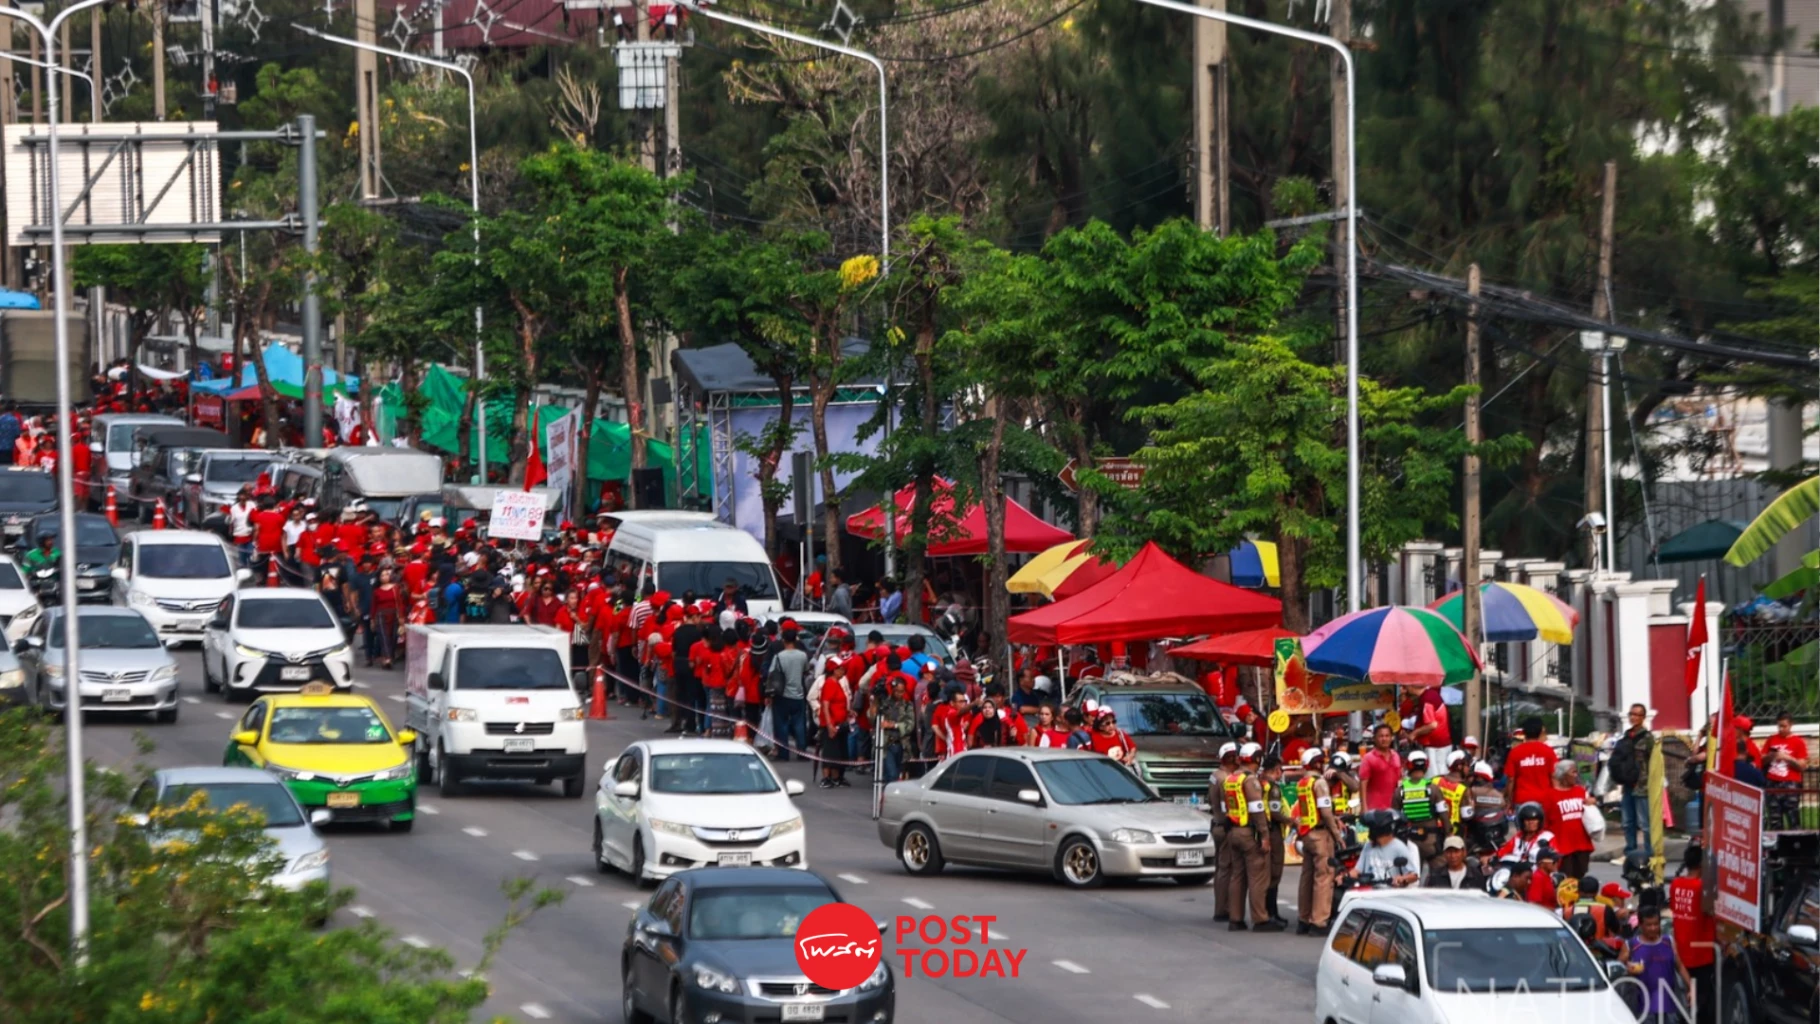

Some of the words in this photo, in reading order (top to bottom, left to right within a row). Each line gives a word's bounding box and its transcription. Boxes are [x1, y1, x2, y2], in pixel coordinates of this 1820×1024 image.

[1270, 714, 1287, 727] 20
[1557, 797, 1583, 814] TONY
[1674, 887, 1694, 898] RED
